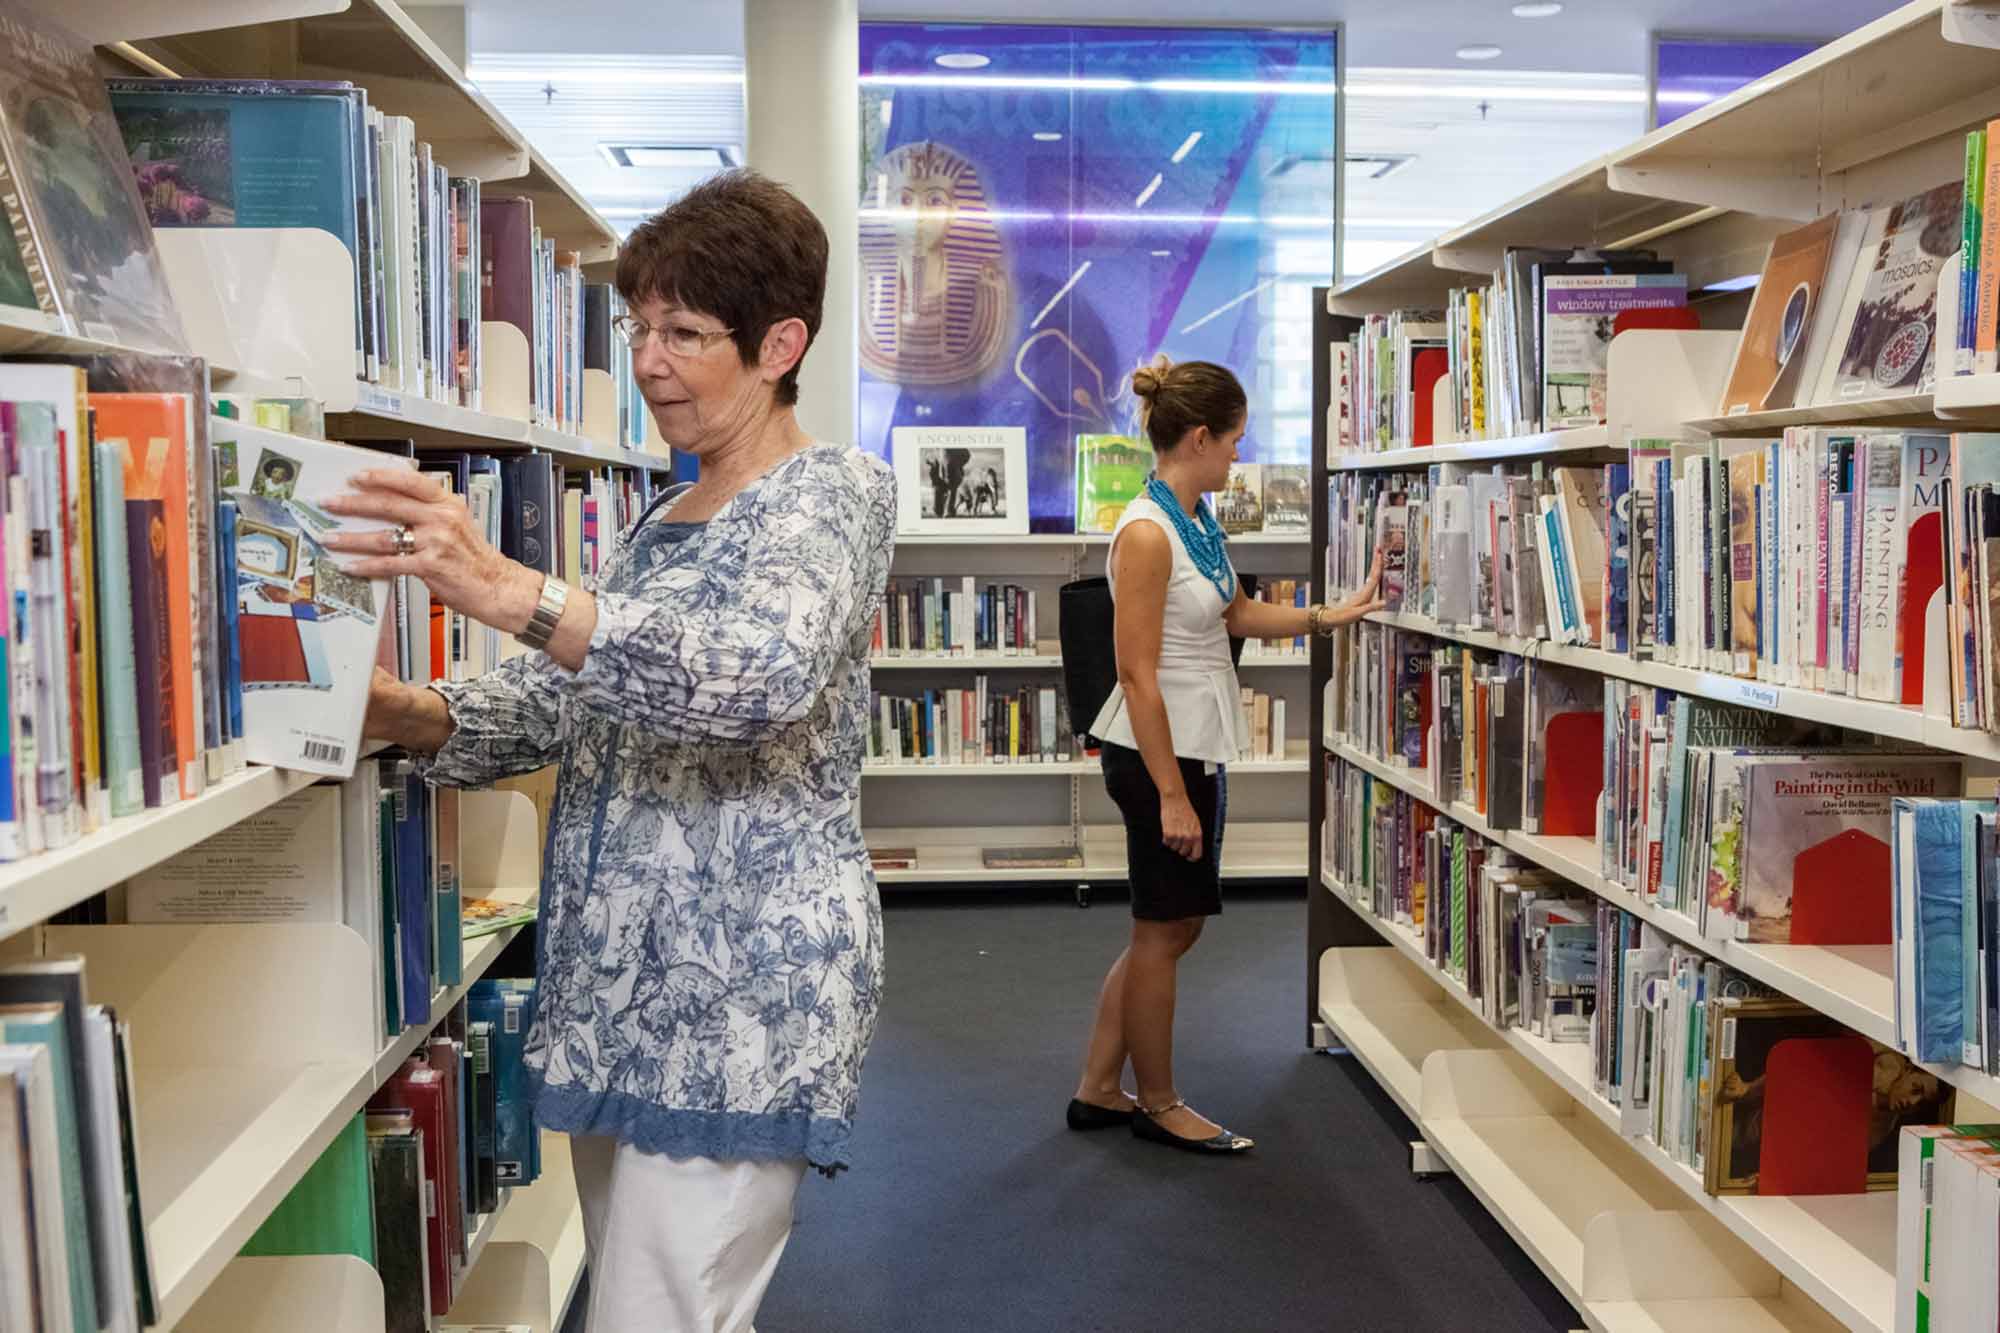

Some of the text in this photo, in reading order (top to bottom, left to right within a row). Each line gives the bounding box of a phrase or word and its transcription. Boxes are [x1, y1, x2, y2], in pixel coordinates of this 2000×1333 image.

[5, 193, 56, 317] PAINTIN
[1880, 258, 1935, 284] mosaics
[1556, 297, 1676, 312] window treatments
[1817, 539, 1828, 593] PAINT
[1862, 504, 1877, 632] MASTERCLASS
[1876, 505, 1897, 630] PAINTING
[1693, 708, 1777, 729] PAINTING
[1692, 727, 1763, 748] NATURE
[1775, 777, 1935, 799] Painting in the Wild
[1822, 799, 1847, 809] David
